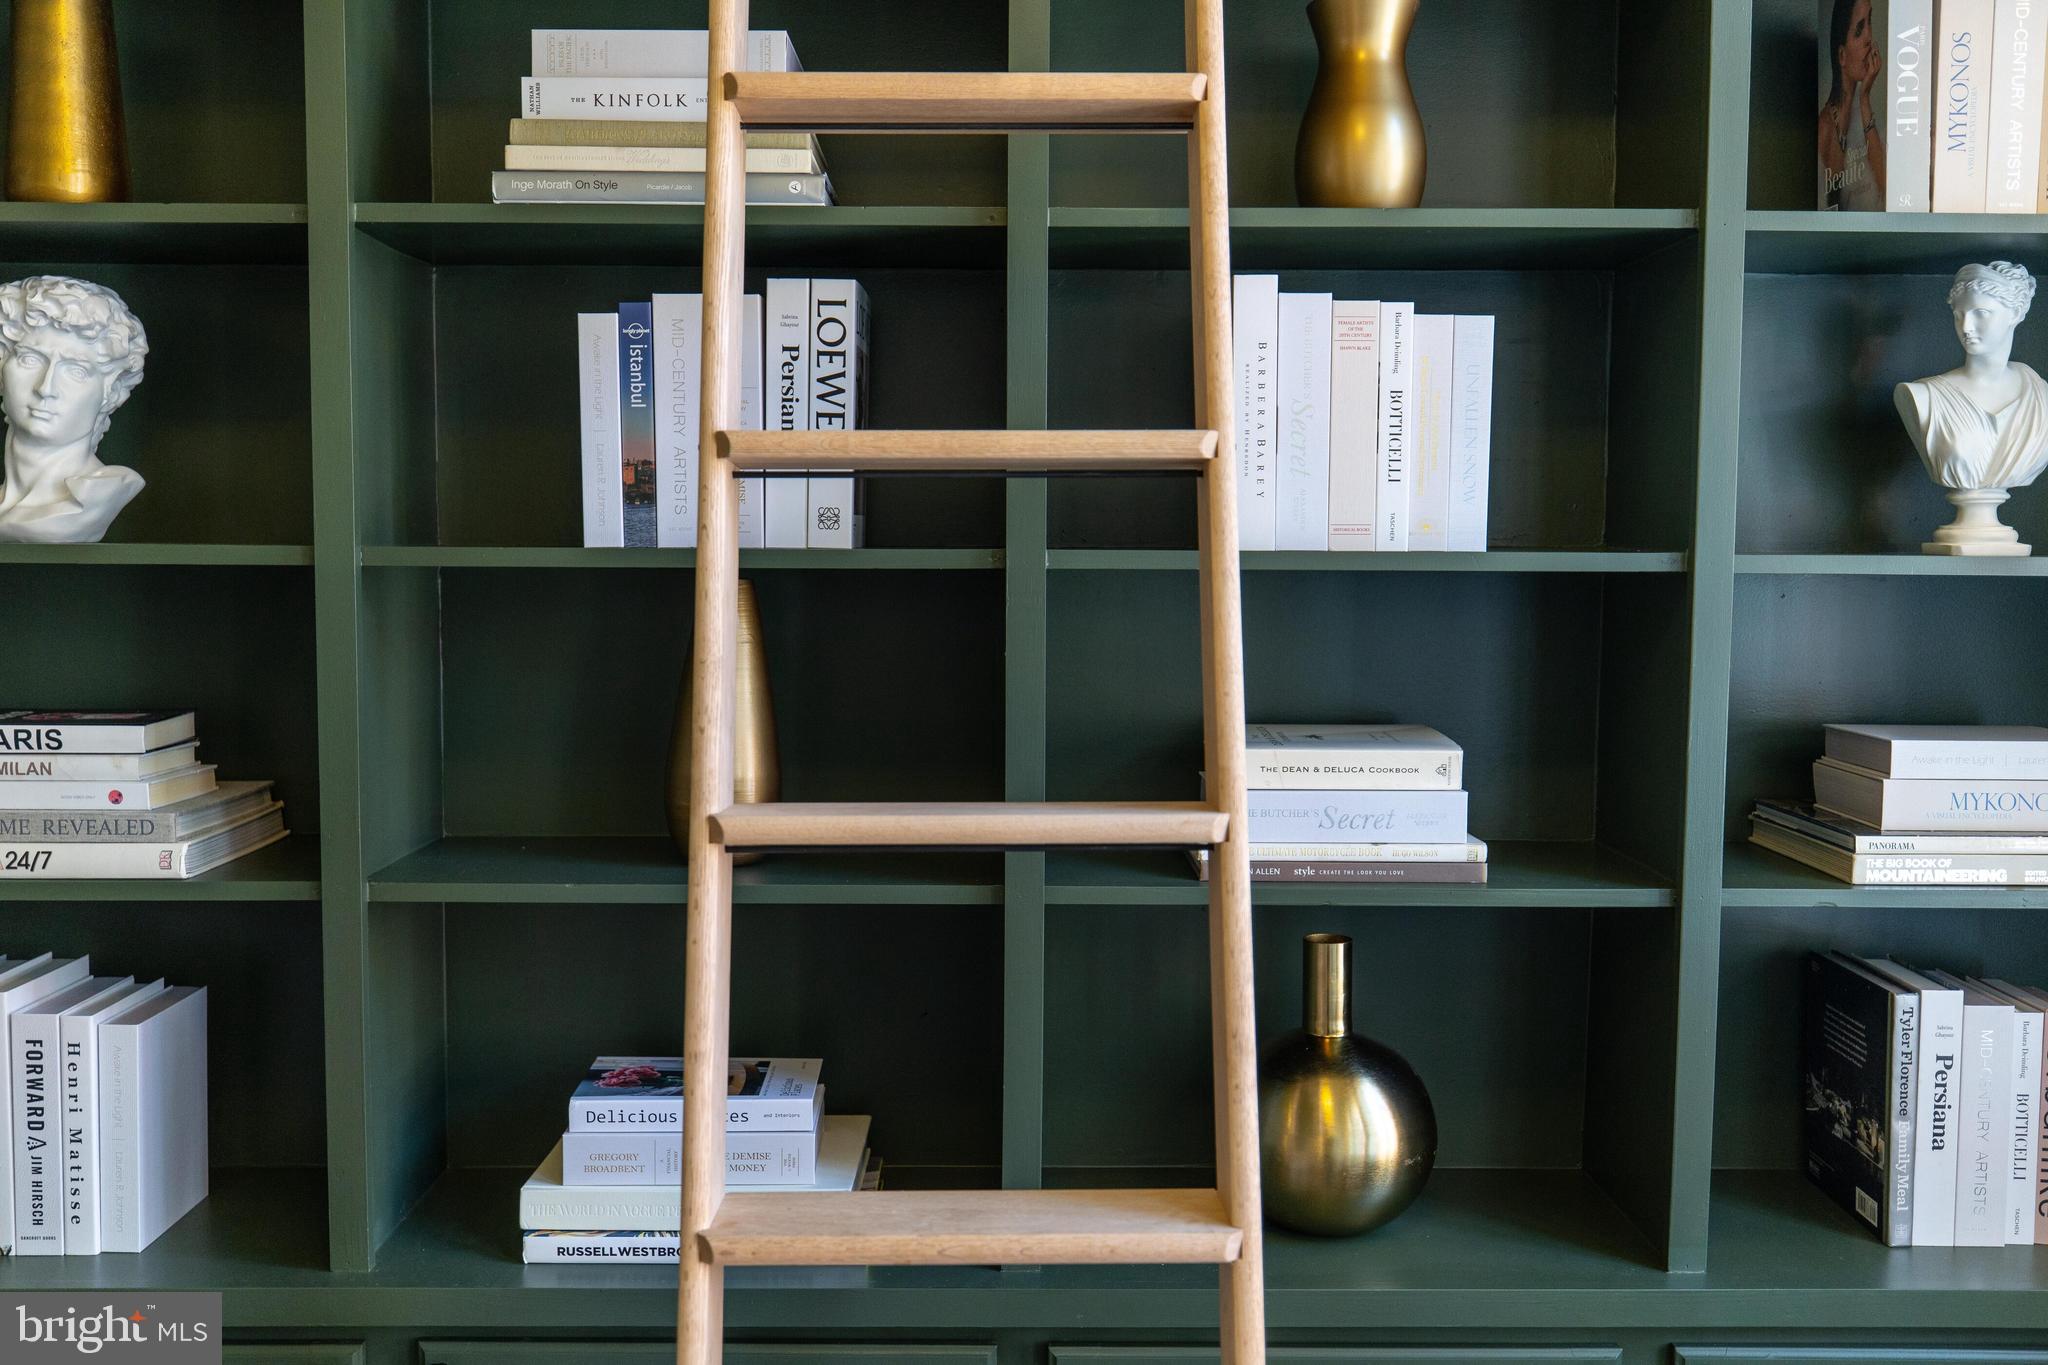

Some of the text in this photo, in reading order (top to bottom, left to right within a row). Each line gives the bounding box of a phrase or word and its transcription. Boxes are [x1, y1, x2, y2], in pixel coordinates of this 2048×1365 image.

[594, 94, 688, 108] KINFOLK
[1897, 25, 1920, 137] VOGUE
[1948, 31, 1972, 152] MYKONOS
[2006, 119, 2024, 191] ARTISTS
[511, 180, 534, 192] Inge
[537, 180, 572, 190] Morath
[575, 180, 592, 190] On
[594, 180, 618, 192] Style
[1394, 312, 1402, 339] Barbara
[671, 318, 687, 437] MID-CENTURY
[816, 299, 847, 430] LOEWE
[1256, 342, 1268, 498] BARBERA BAREY
[1290, 399, 1316, 480] Secret
[1388, 390, 1404, 482] BOTTICELLI
[673, 447, 688, 515] ARTISTS
[1462, 454, 1477, 504] SNOW
[1282, 765, 1309, 773] DEAN
[1324, 765, 1365, 774] DELUCA
[1368, 766, 1420, 774] COOKBOOK
[43, 819, 155, 836] REVEALED
[1260, 808, 1320, 818] BUTCHER'S
[1318, 805, 1396, 830] Secret
[5, 851, 52, 872] 24/7
[1257, 848, 1297, 857] ULTIMATE
[1355, 848, 1383, 857] BOOK
[1866, 859, 1952, 868] THE BIG BOOK OF
[1869, 842, 1915, 850] PANORAMA
[1294, 866, 1316, 877] style
[1865, 869, 2007, 883] MOUNTAINEERING
[1900, 1007, 1914, 1049] Tyler
[2022, 1021, 2031, 1047] Barbara
[1899, 1050, 1913, 1117] Florence
[1931, 1053, 1954, 1151] Persiana
[1976, 1029, 1994, 1147] MID-CENTURY
[25, 1040, 45, 1226] FORWARD JIM HIRSCH
[67, 1042, 84, 1225] Henri Matisse
[586, 1110, 678, 1124] Delicious
[2013, 1093, 2030, 1180] BOTTICELLI
[589, 1153, 639, 1162] GREGORY
[733, 1152, 771, 1160] DEMISE
[1896, 1120, 1910, 1173] Family
[584, 1164, 767, 1173] BROADBENT MONEY
[1973, 1151, 1988, 1217] ARTISTS
[528, 1203, 555, 1217] THE
[558, 1203, 605, 1217] WORLD
[623, 1203, 664, 1217] VOGUE
[1896, 1175, 1909, 1211] Meal
